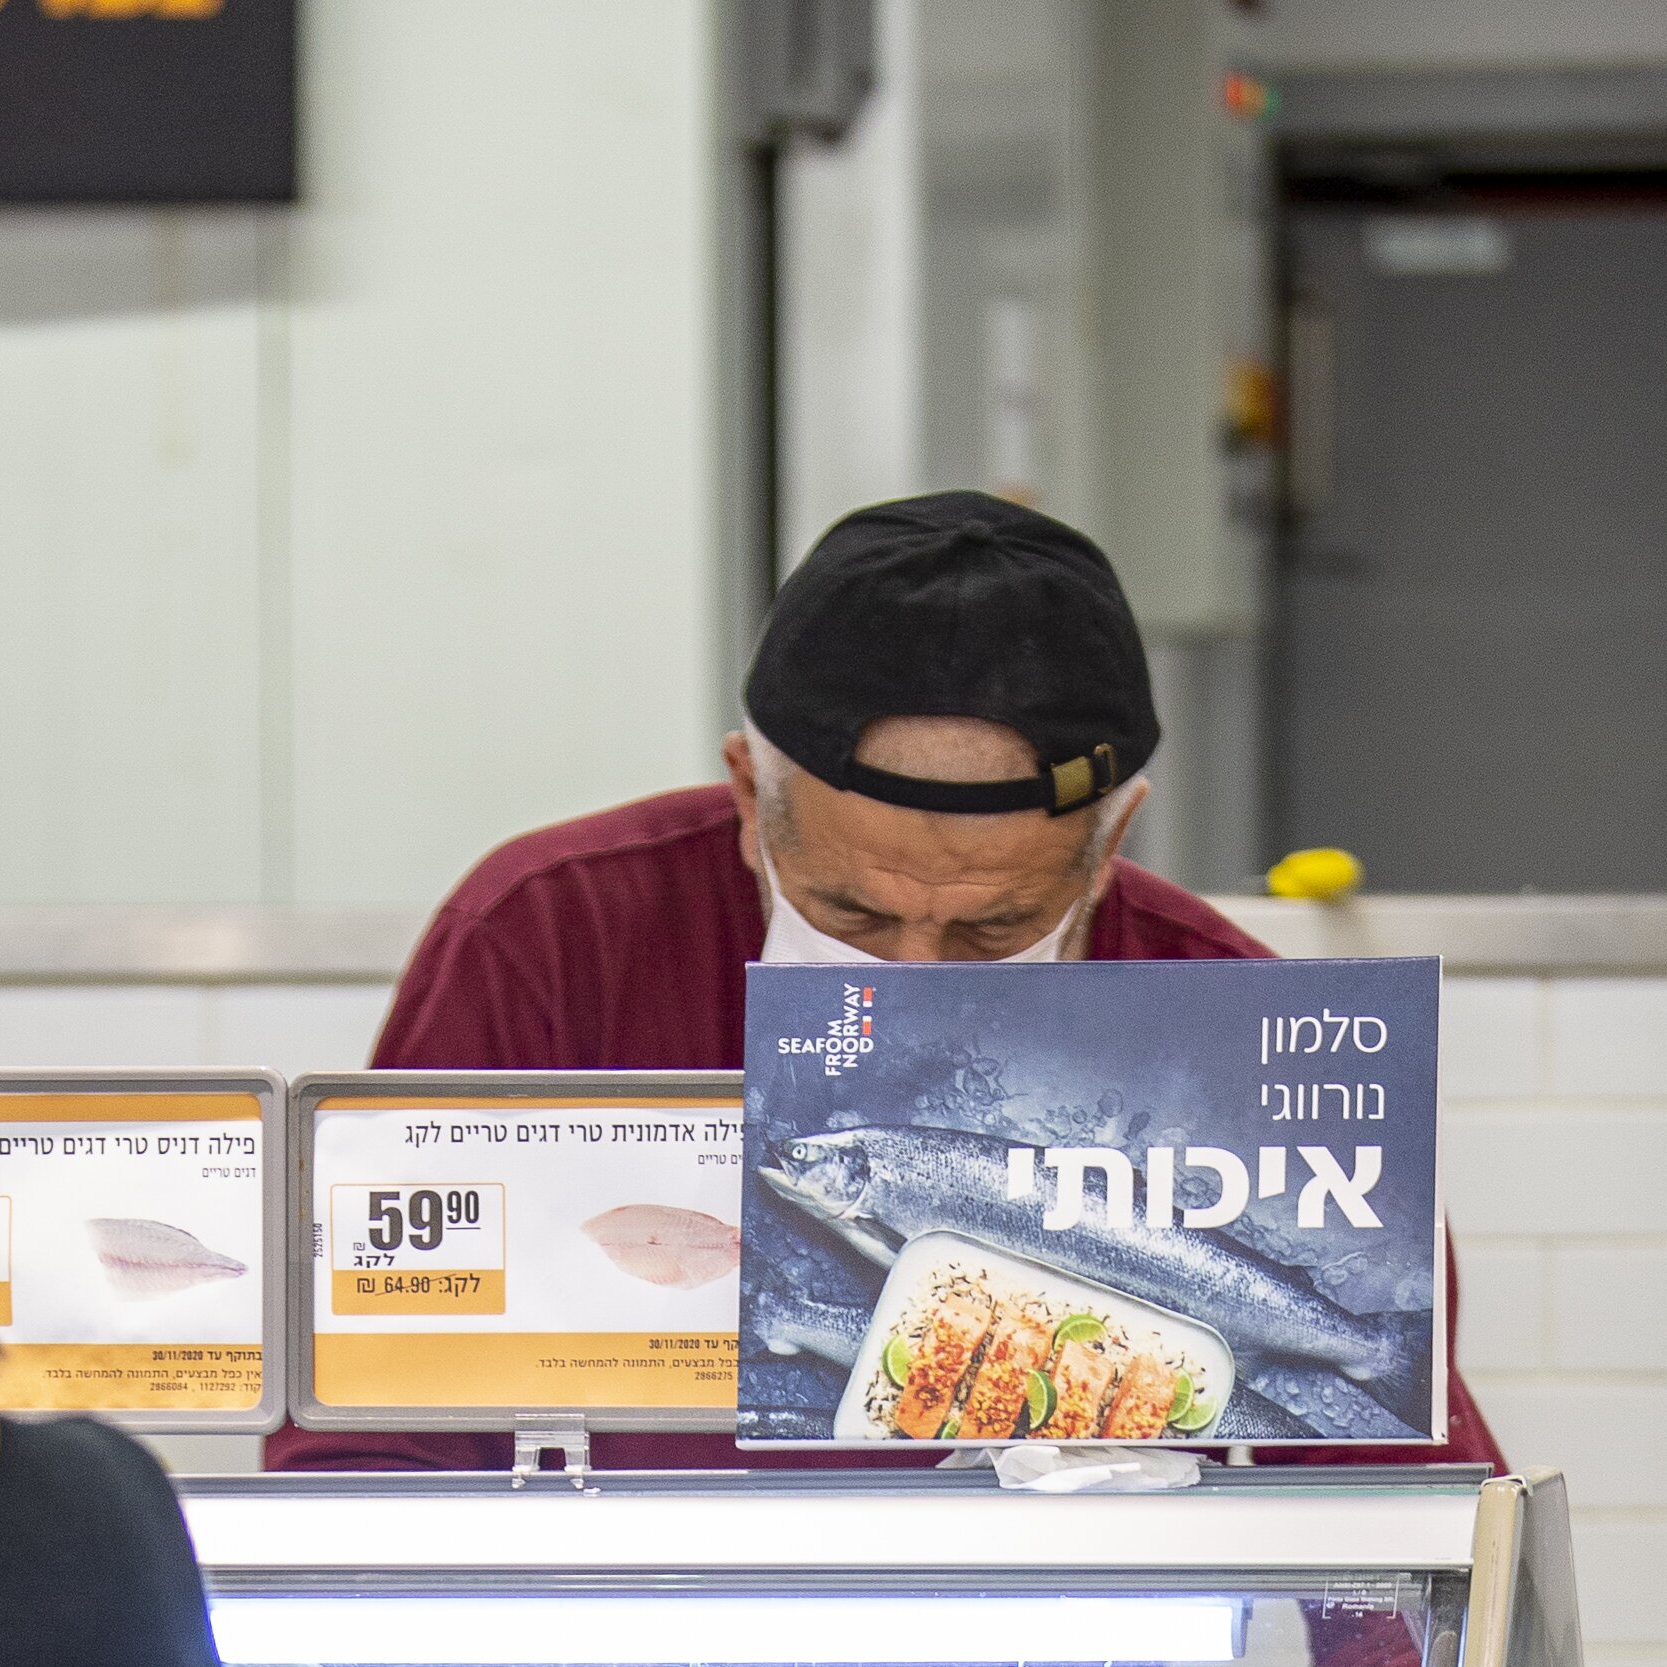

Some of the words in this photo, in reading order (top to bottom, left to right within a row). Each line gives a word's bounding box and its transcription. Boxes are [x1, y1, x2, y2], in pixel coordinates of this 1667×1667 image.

[843, 983, 860, 1068] NORWAY
[1260, 1008, 1388, 1065] סלמון
[778, 1037, 874, 1054] SEAFOOD
[825, 1019, 842, 1076] FROM
[1260, 1082, 1386, 1121] נורווגי
[405, 1121, 441, 1148] לקג
[451, 1125, 507, 1143] טריים
[517, 1125, 560, 1143] דגים
[569, 1124, 602, 1143] טרי
[612, 1123, 695, 1143] אדמונית
[63, 1136, 106, 1155] דגים
[115, 1136, 148, 1155] טרי
[157, 1136, 199, 1155] דניס
[208, 1133, 256, 1155] פילה
[698, 1154, 728, 1165] טריים
[202, 1167, 230, 1178] טריים
[234, 1167, 256, 1178] דגים
[1007, 1145, 1384, 1231] איכותי
[368, 1190, 443, 1251] 59
[353, 1253, 395, 1268] לקג
[384, 1277, 431, 1293] 64.90
[438, 1273, 481, 1297] לקג:
[649, 1339, 700, 1349] 30/11/2020
[704, 1340, 719, 1349] עד
[152, 1350, 203, 1361] 30/11/2020
[209, 1351, 222, 1361] עד
[226, 1351, 262, 1362] בתוקף
[570, 1358, 618, 1368] להמחשה
[623, 1359, 665, 1368] התמונה
[76, 1369, 122, 1379] להמחשה
[127, 1370, 168, 1379] התמונה
[222, 1369, 243, 1379] כפל
[246, 1370, 262, 1381] אין
